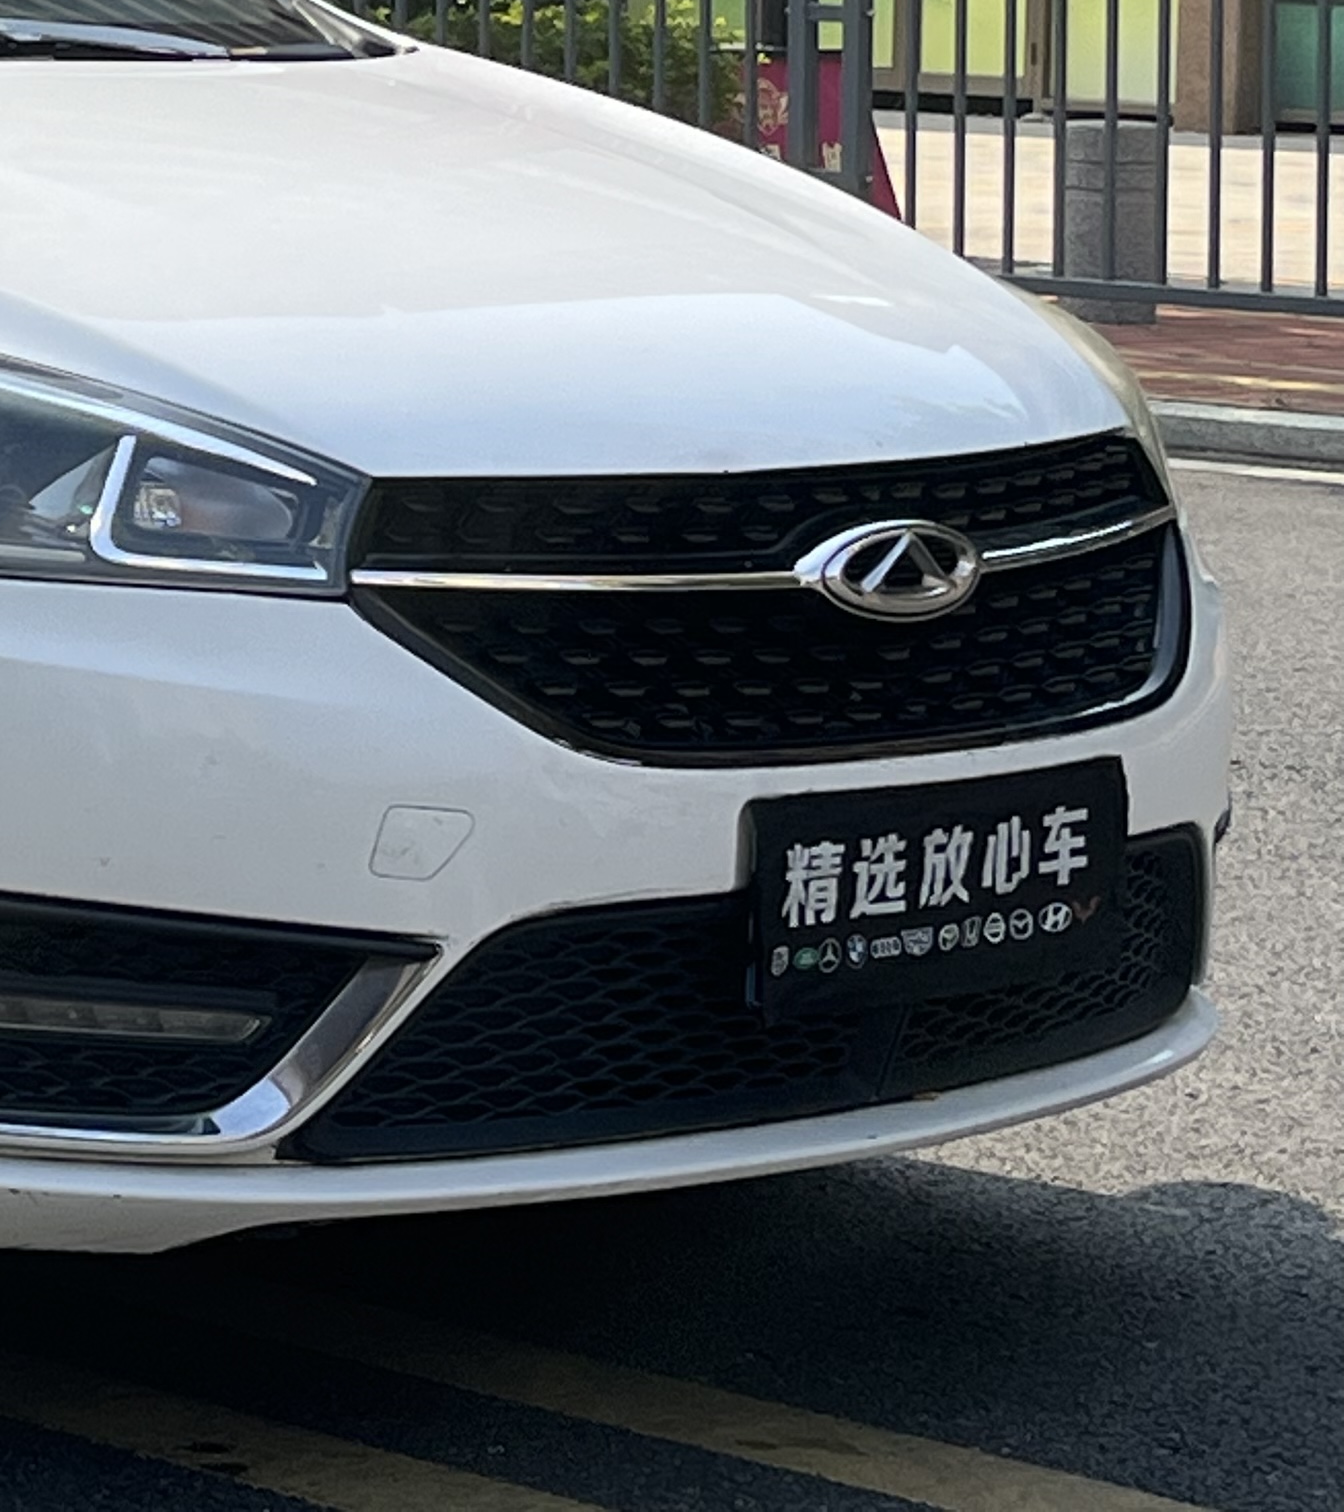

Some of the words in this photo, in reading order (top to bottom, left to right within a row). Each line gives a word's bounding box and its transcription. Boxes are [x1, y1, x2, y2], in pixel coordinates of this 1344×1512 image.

[781, 805, 1089, 928] 精选放心车
